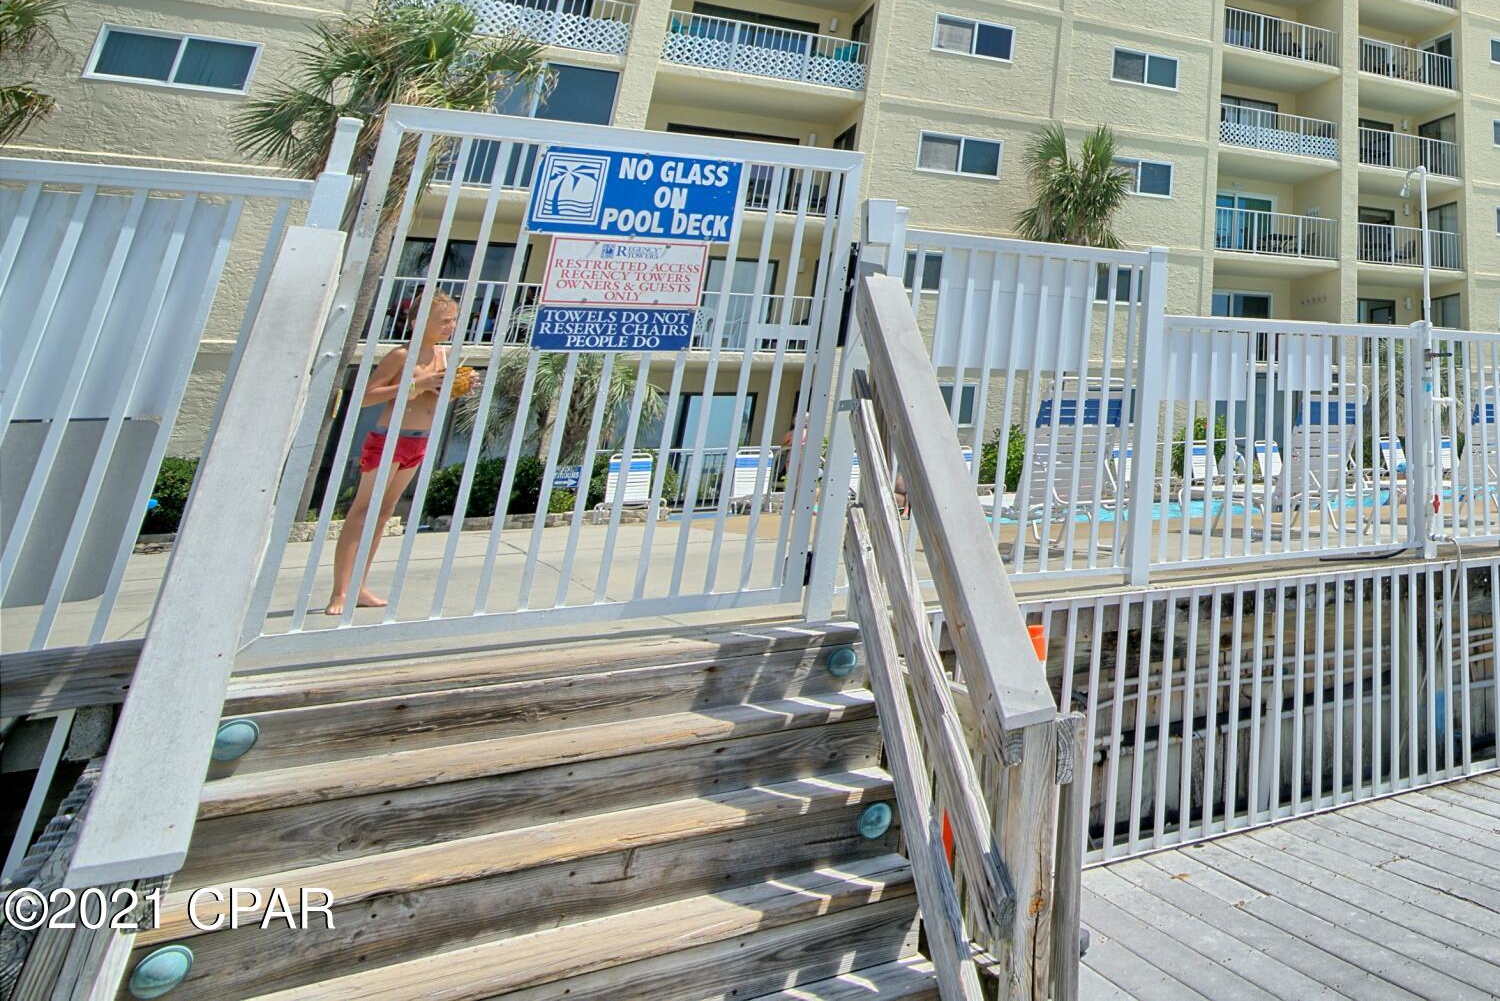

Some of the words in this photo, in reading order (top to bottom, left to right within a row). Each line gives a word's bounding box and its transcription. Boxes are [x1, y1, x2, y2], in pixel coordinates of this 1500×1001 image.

[618, 156, 654, 181] NO
[660, 160, 730, 187] GLASS
[654, 186, 688, 209] ON
[600, 207, 664, 234] POOL
[670, 212, 730, 238] DECK
[554, 258, 648, 272] RESTRICTED
[651, 262, 701, 274] ACCESS
[560, 269, 631, 281] REGENCY
[635, 272, 691, 283] TOWERS
[556, 279, 620, 291] OWNERS
[623, 282, 634, 291] &
[639, 282, 692, 293] GUESTS
[604, 291, 642, 302] ONLY
[543, 309, 617, 323] TOWELS
[621, 311, 649, 324] DO
[652, 312, 690, 325] NOT
[538, 322, 618, 335] RESERVE
[621, 324, 689, 336] CHAIRS
[565, 334, 629, 348] PEOPLE
[632, 335, 660, 348] DO
